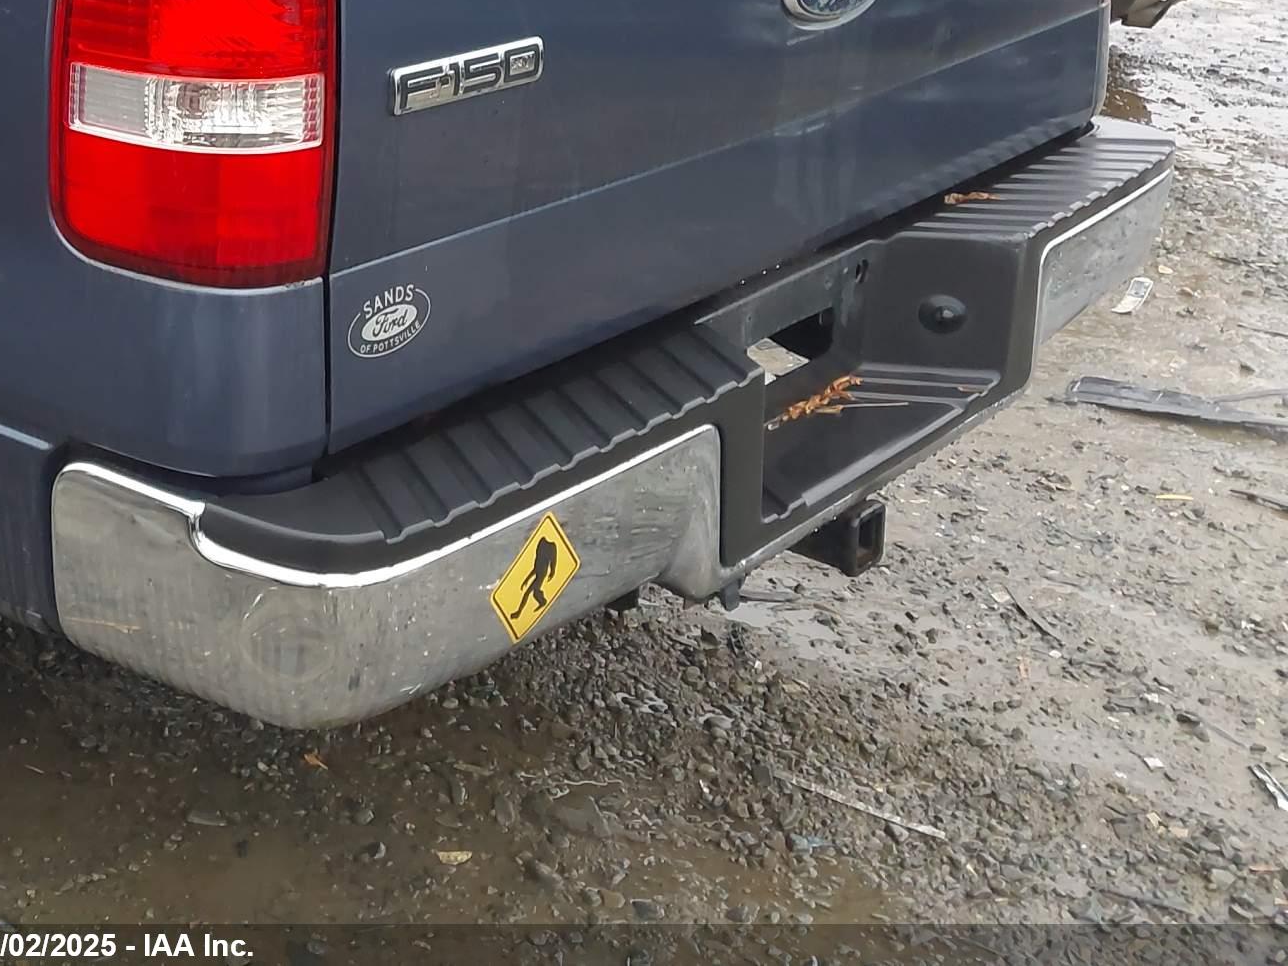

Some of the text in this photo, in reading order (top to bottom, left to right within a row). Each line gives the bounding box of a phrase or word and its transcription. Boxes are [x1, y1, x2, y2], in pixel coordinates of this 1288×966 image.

[363, 283, 415, 320] SANDS
[359, 320, 421, 354] OF POTTSVILLE
[372, 307, 409, 338] Ford
